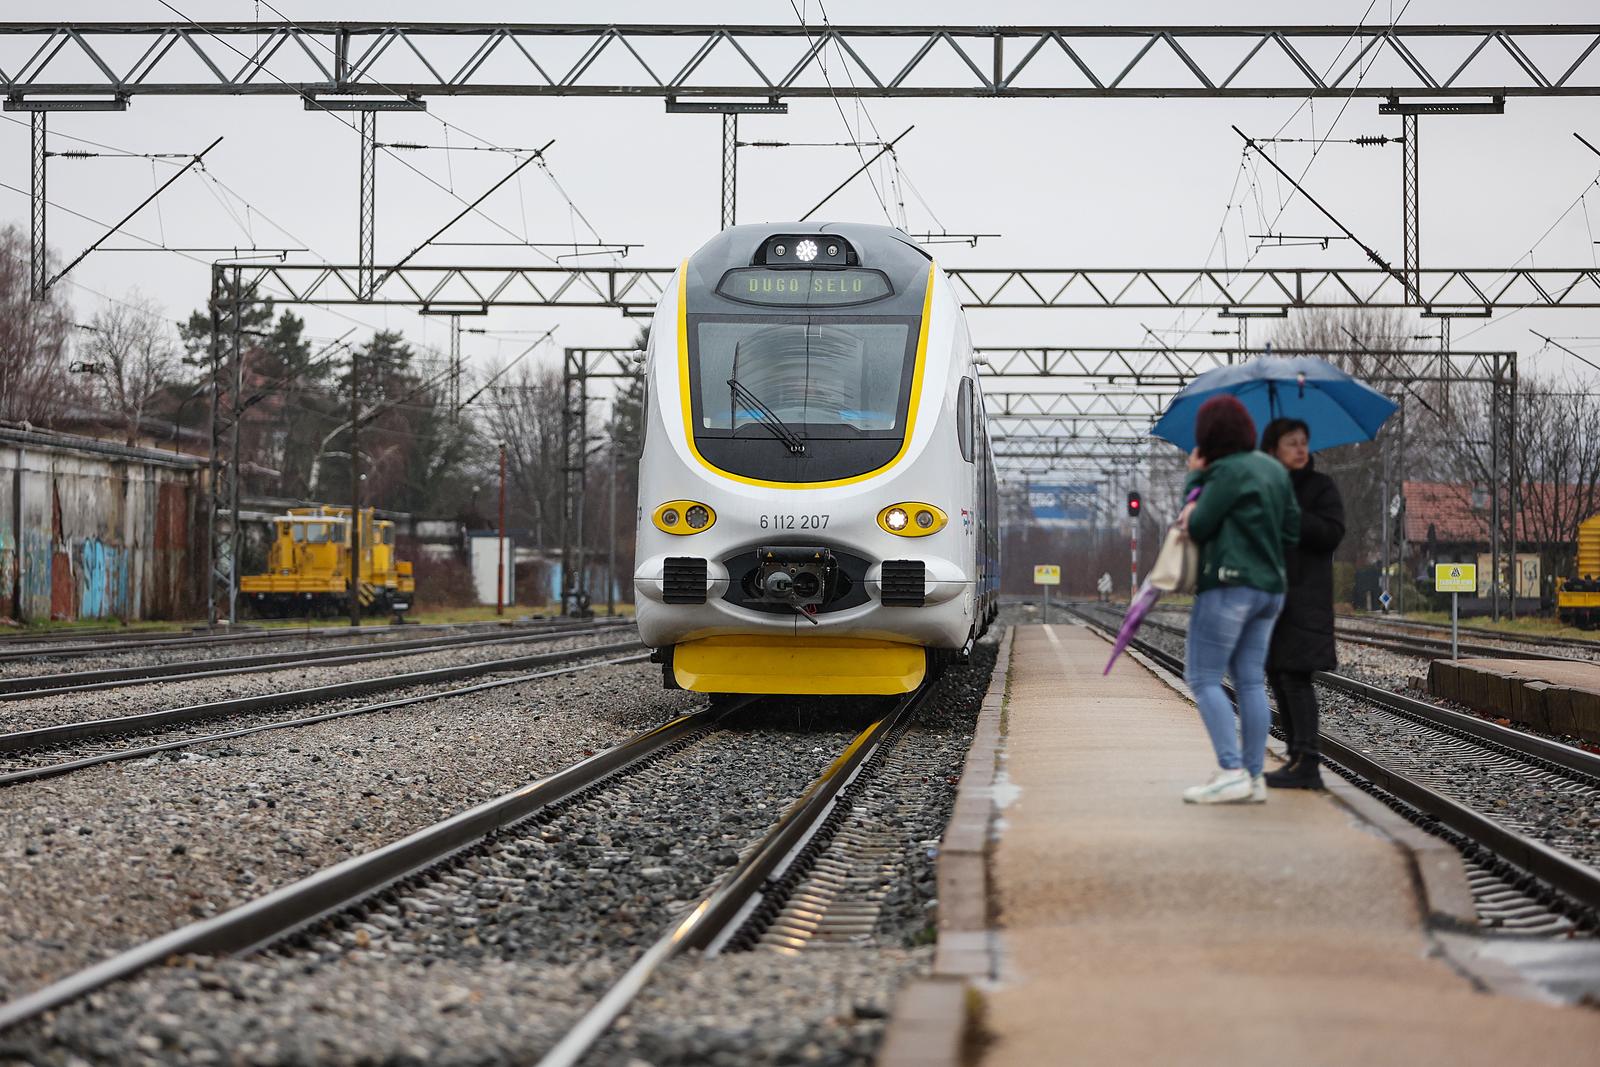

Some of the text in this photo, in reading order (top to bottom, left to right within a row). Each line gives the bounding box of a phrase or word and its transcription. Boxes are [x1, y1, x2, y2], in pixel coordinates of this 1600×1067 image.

[749, 278, 863, 292] DUGO SELO
[760, 514, 830, 529] 6 112 207
